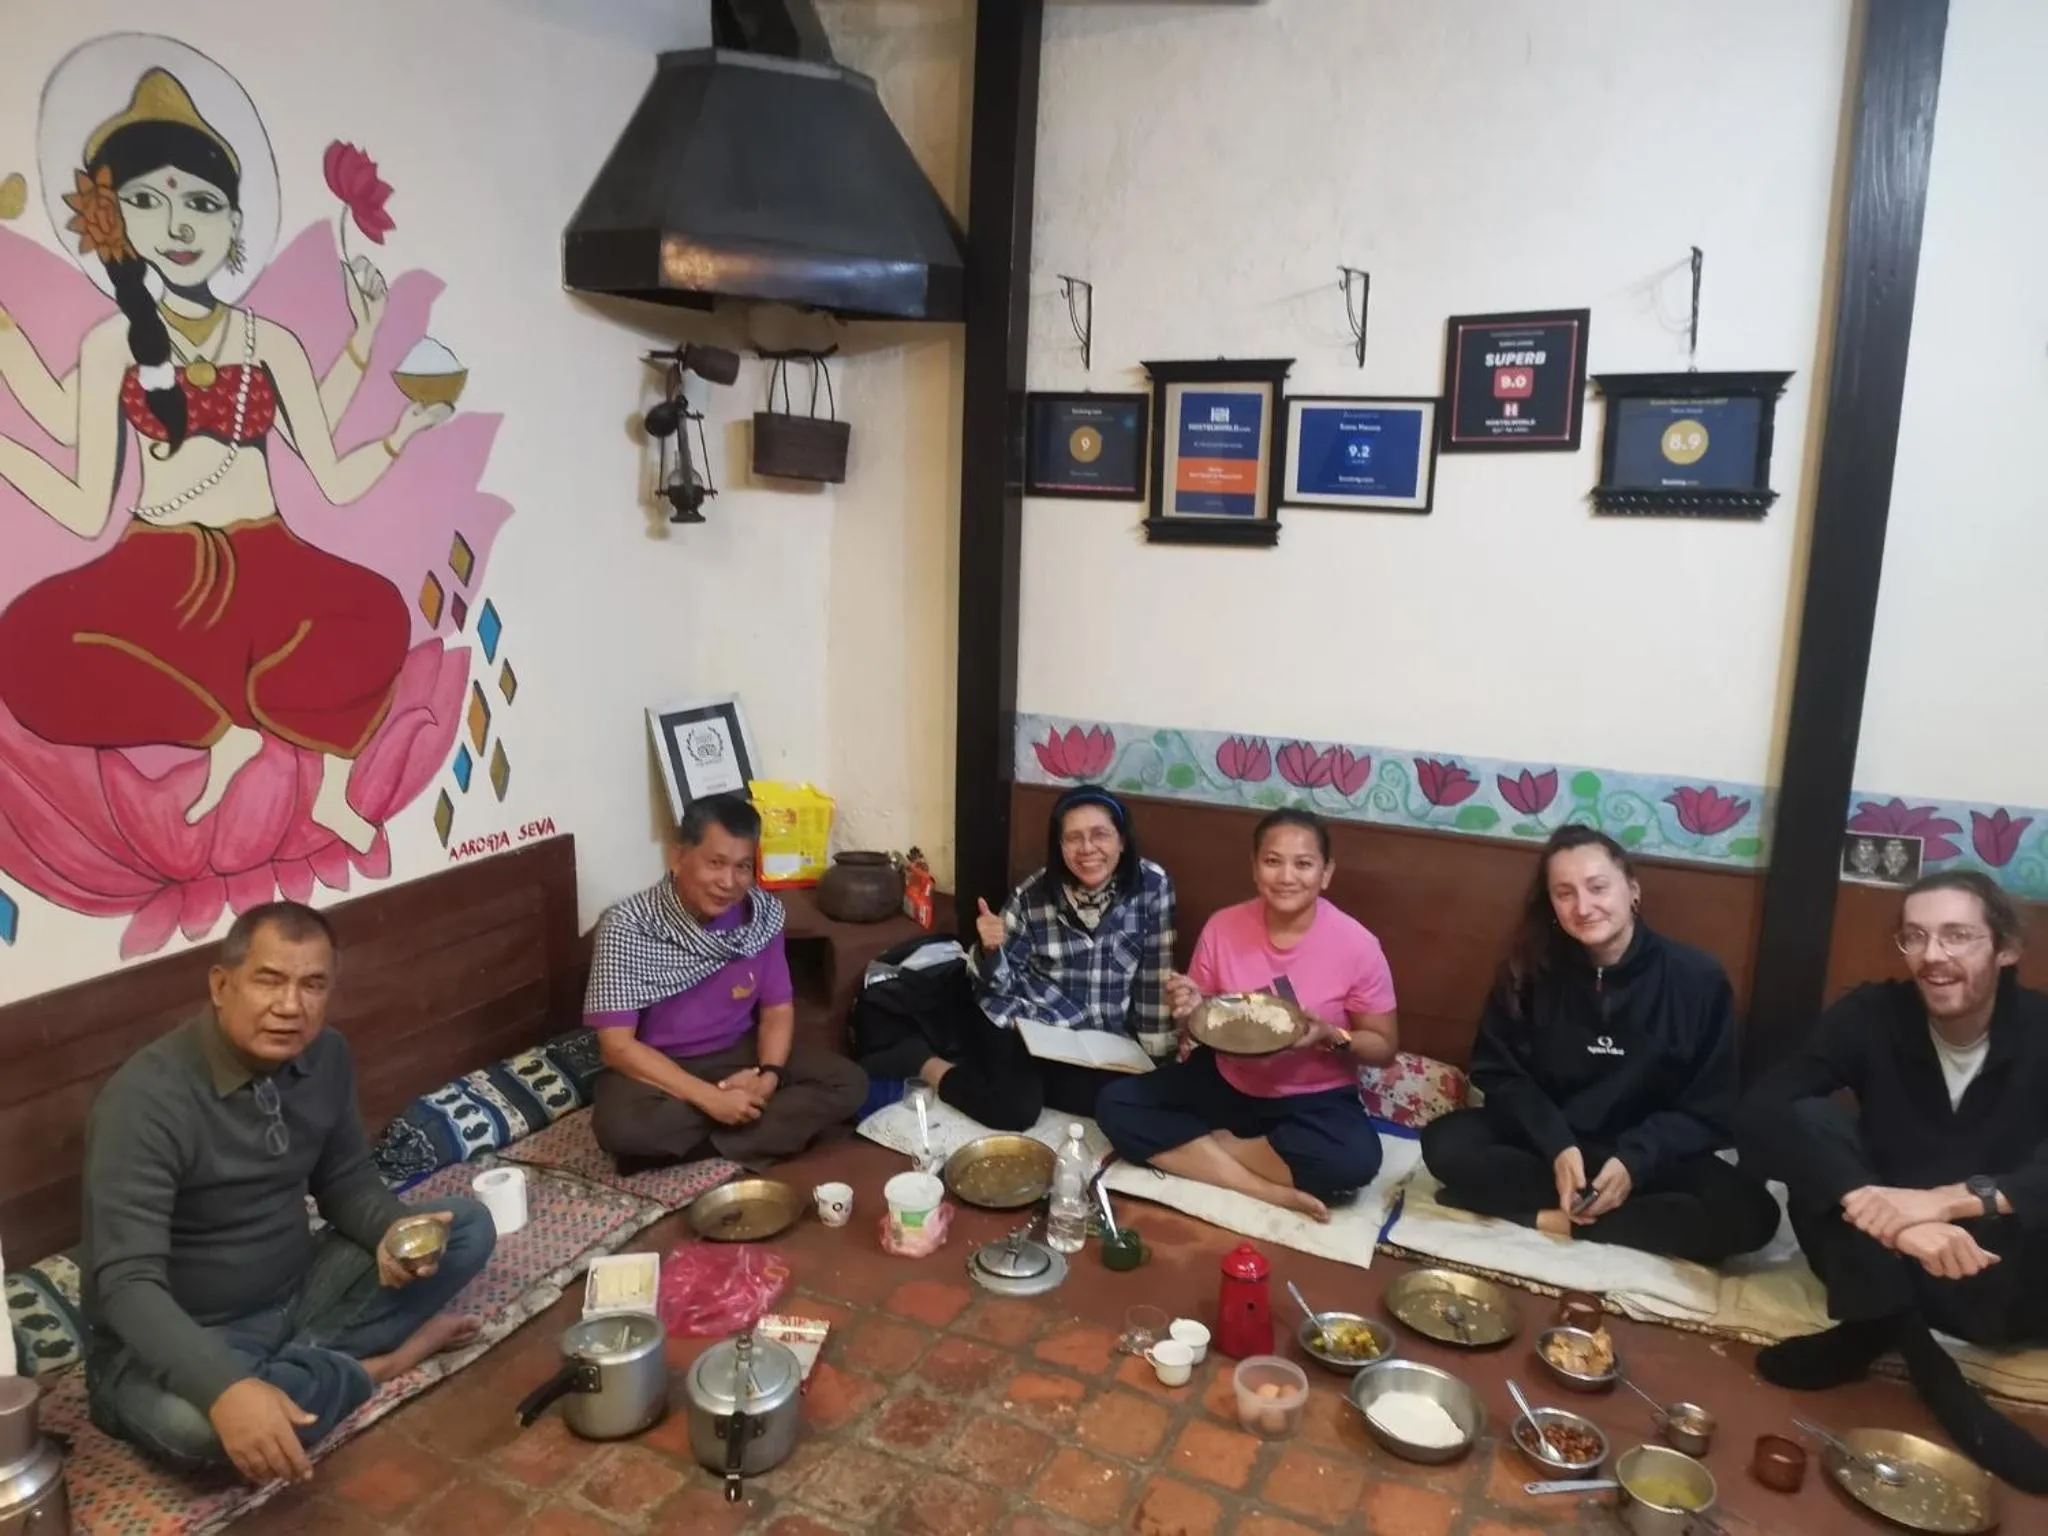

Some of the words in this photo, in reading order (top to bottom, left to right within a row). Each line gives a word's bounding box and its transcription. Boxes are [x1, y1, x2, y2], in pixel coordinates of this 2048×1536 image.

[1484, 351, 1547, 367] SUPERB
[1348, 444, 1371, 458] 9.2
[517, 816, 555, 841] SEVA
